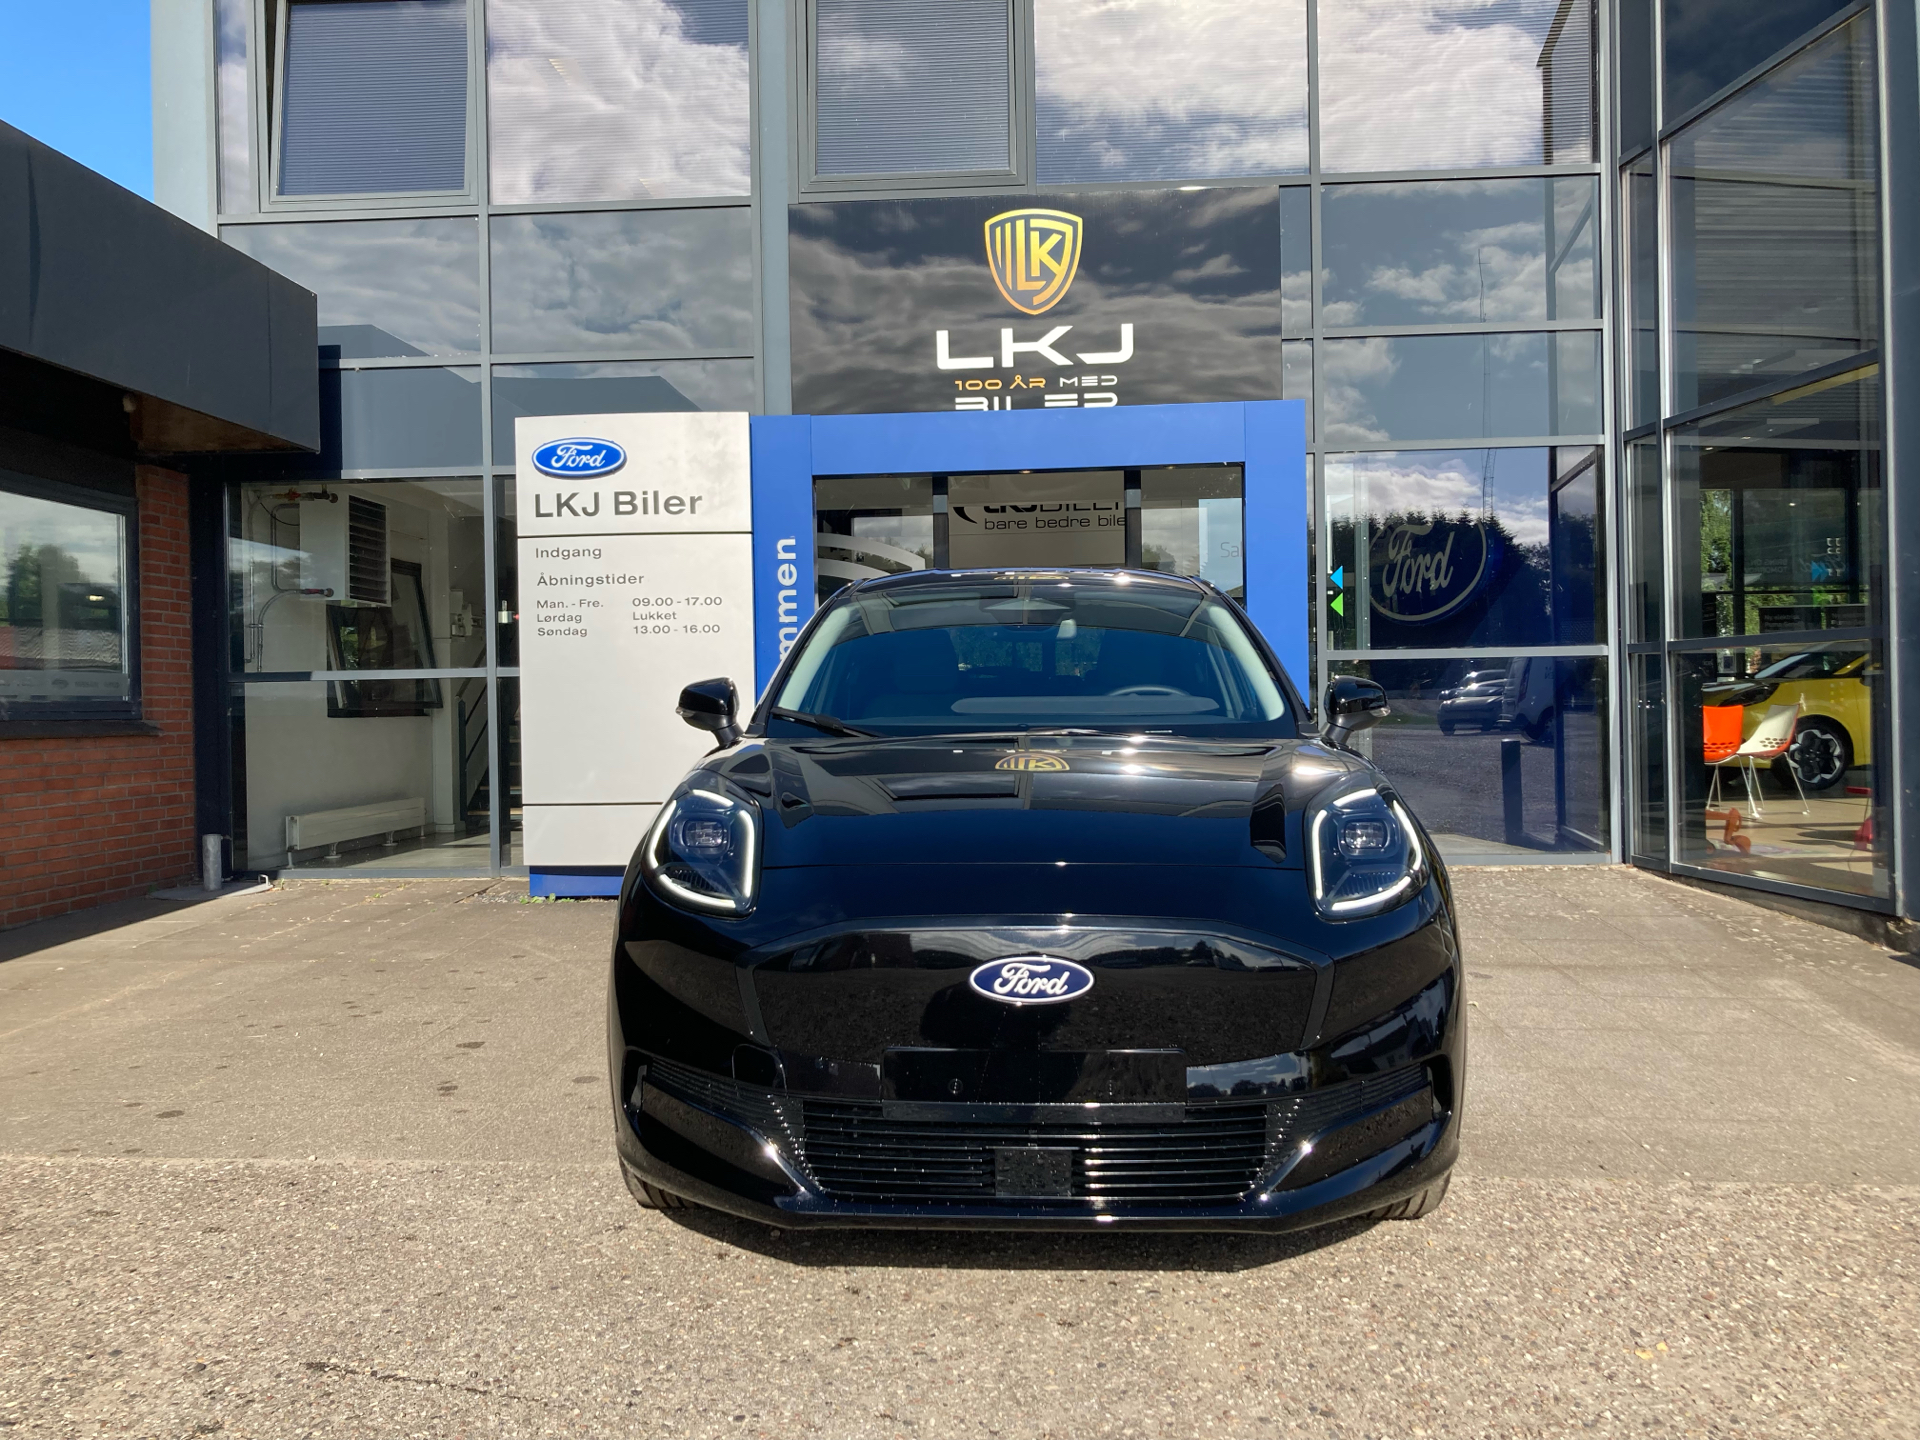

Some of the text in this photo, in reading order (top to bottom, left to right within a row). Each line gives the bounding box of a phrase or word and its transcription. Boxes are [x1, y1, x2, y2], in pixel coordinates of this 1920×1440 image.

[936, 323, 1134, 370] LKJ
[955, 374, 1118, 391] 100 ÅR MED
[551, 444, 607, 468] Ford
[535, 490, 703, 518] LKJ Biler
[984, 518, 1028, 530] bare
[1035, 516, 1091, 529] bedre
[535, 547, 602, 560] Indgang
[1382, 522, 1456, 597] Ford
[537, 571, 645, 588] Åbningstider
[536, 599, 569, 609] Man.
[579, 598, 604, 608] Fre.
[632, 597, 674, 607] 09.00
[684, 596, 723, 606] 17.00
[537, 611, 677, 624] Lørdag Lukket
[537, 627, 588, 637] Søndag
[634, 625, 671, 635] 13.00
[682, 624, 721, 634] 16.00
[993, 962, 1070, 995] Ford
